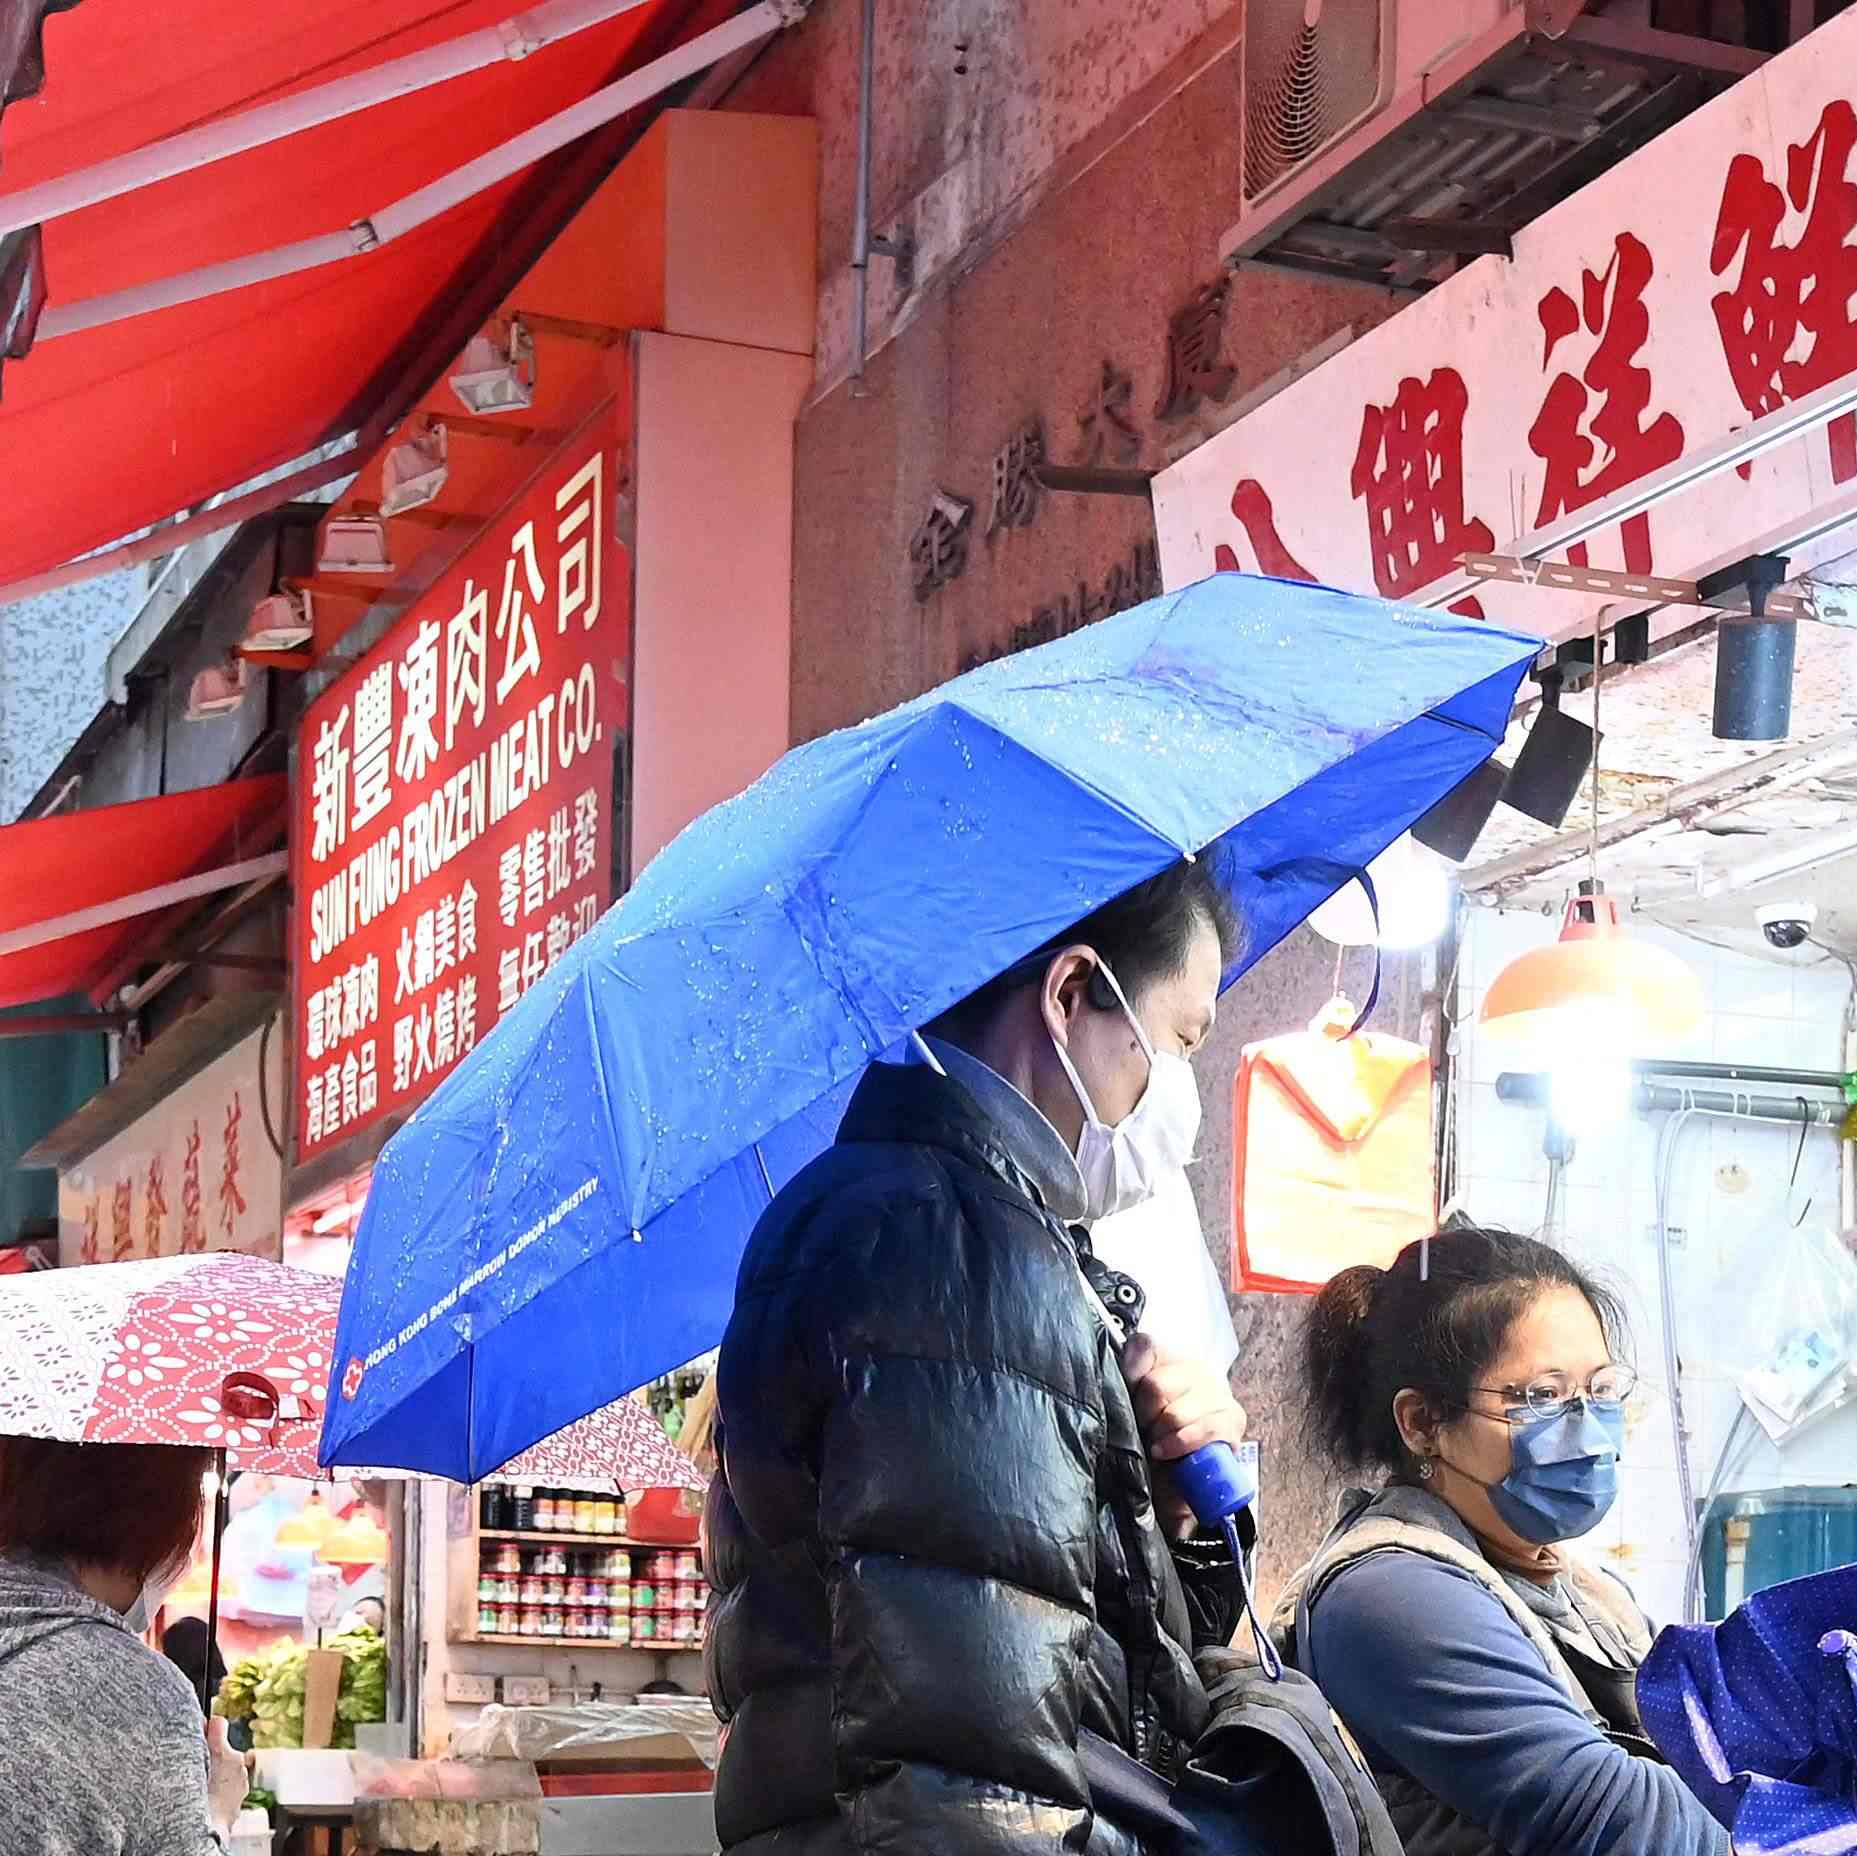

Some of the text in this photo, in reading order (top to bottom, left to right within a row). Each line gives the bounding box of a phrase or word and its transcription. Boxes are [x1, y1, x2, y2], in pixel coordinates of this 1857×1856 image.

[311, 451, 605, 864] 新豐凍肉公司
[311, 662, 602, 964] SUN FUNG FROZEN MEAT CO.
[393, 878, 479, 1007] 火鍋美食
[499, 787, 599, 928] 零售批發
[364, 1175, 600, 1370] HONG KONG BONE MARROW DONOR REGISTRY
